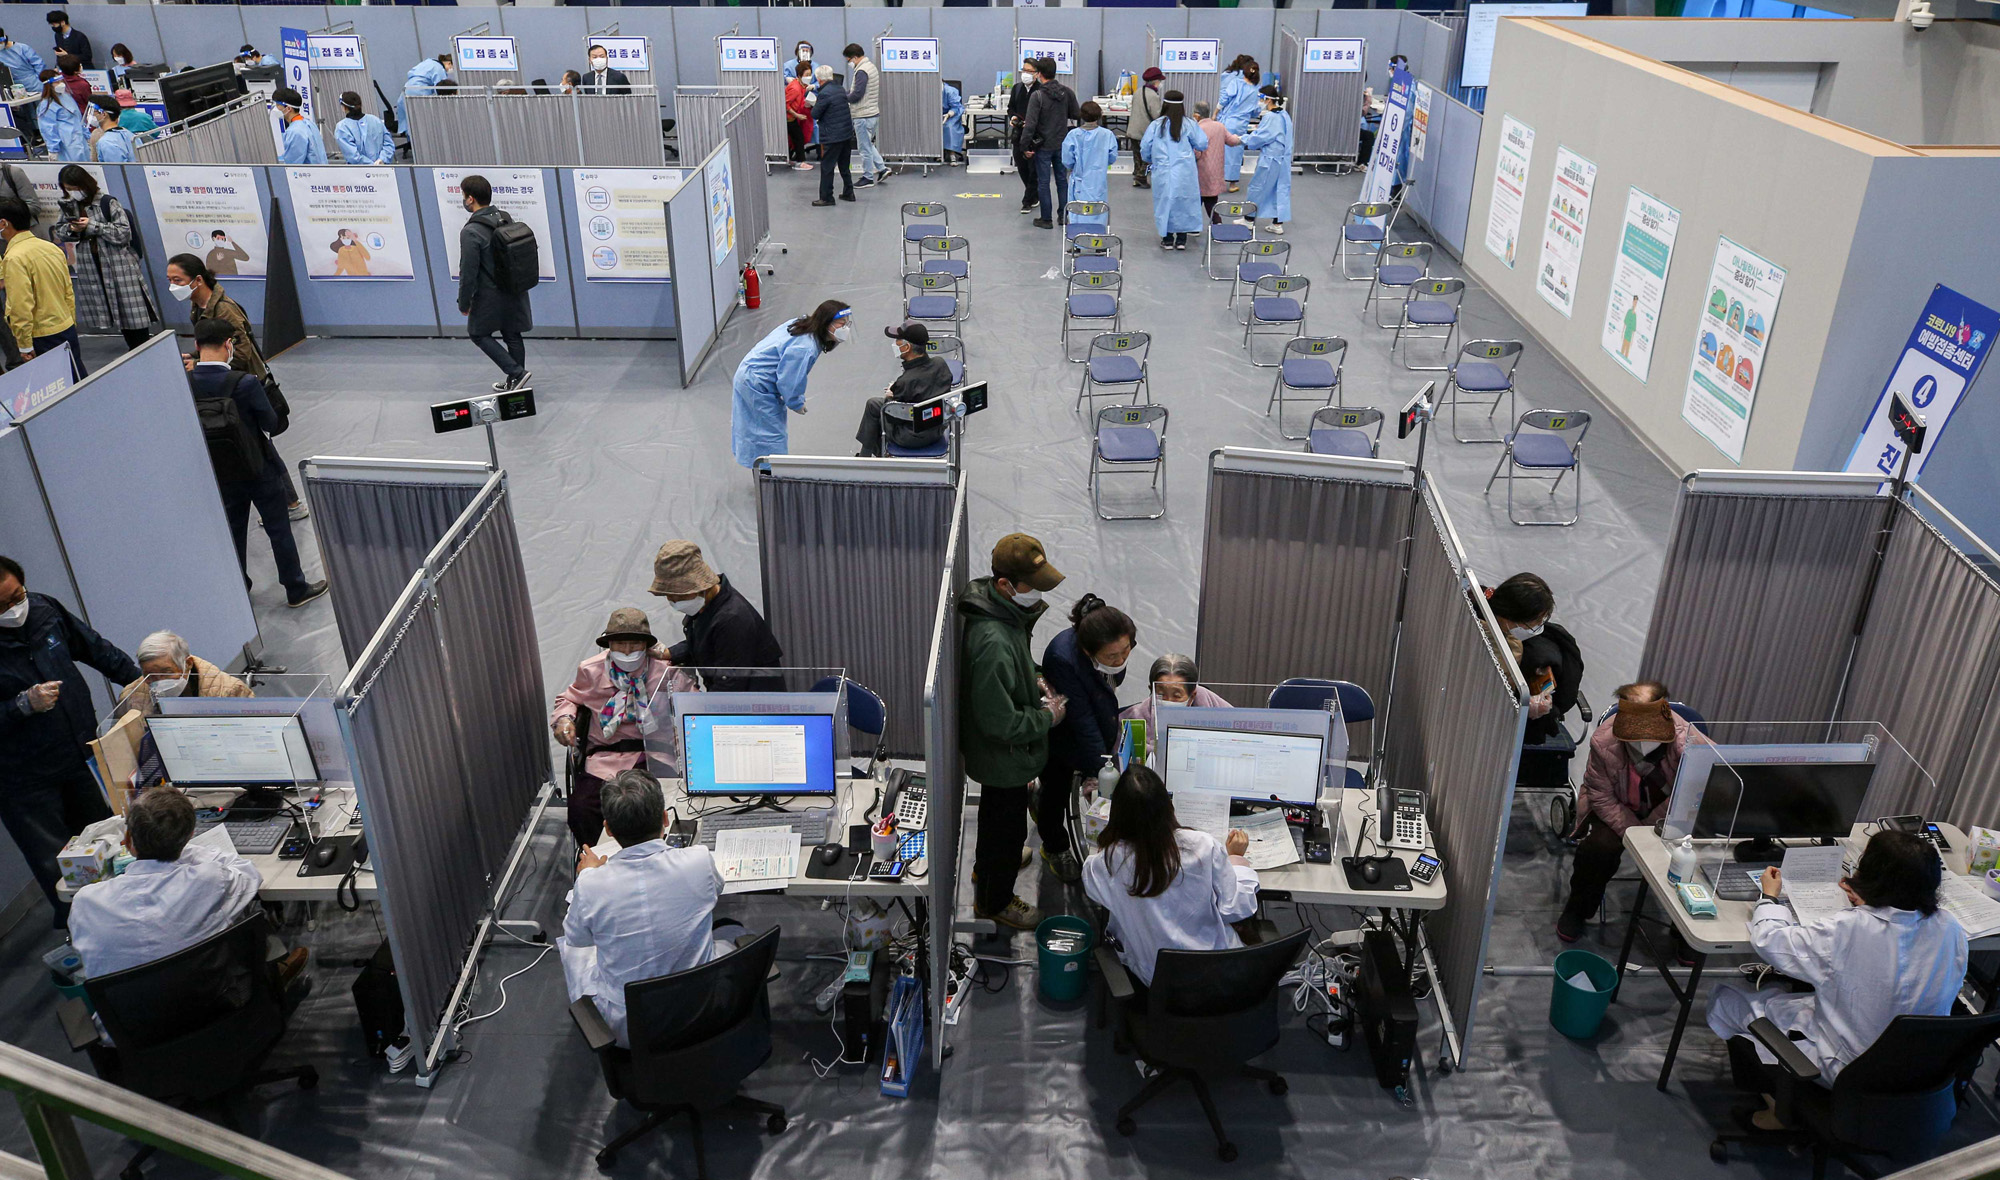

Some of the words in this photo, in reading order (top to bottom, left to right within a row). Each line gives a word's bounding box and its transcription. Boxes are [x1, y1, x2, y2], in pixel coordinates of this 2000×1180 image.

[322, 47, 354, 57] 접종실
[476, 49, 508, 59] 접종실
[608, 49, 640, 58] 접종실
[738, 49, 770, 59] 접종실
[899, 50, 931, 59] 접종실
[1179, 51, 1210, 60] 접종실
[1323, 50, 1354, 60] 접종실
[1382, 133, 1398, 154] 접종
[169, 186, 183, 194] 접종
[184, 186, 192, 194] 후
[310, 185, 331, 193] 전신에
[332, 185, 352, 193] 통증이
[354, 185, 378, 193] 있어요.
[492, 186, 519, 194] 복용하는
[520, 186, 534, 194] 경우
[1732, 255, 1764, 277] 아나필락시스
[924, 278, 935, 286] 12
[1092, 276, 1100, 284] 11
[1734, 270, 1746, 284] 증상
[1745, 275, 1756, 290] 알기
[1278, 281, 1288, 289] 10
[1926, 313, 1958, 338] 코로나19
[927, 342, 938, 351] 16
[1117, 338, 1129, 348] 15
[1313, 343, 1324, 352] 14
[1488, 347, 1501, 356] 13
[1918, 328, 1976, 370] 예방접종센터
[1915, 379, 1934, 405] 4
[1126, 412, 1139, 421] 19
[1344, 414, 1357, 424] 18
[1552, 418, 1566, 428] 17
